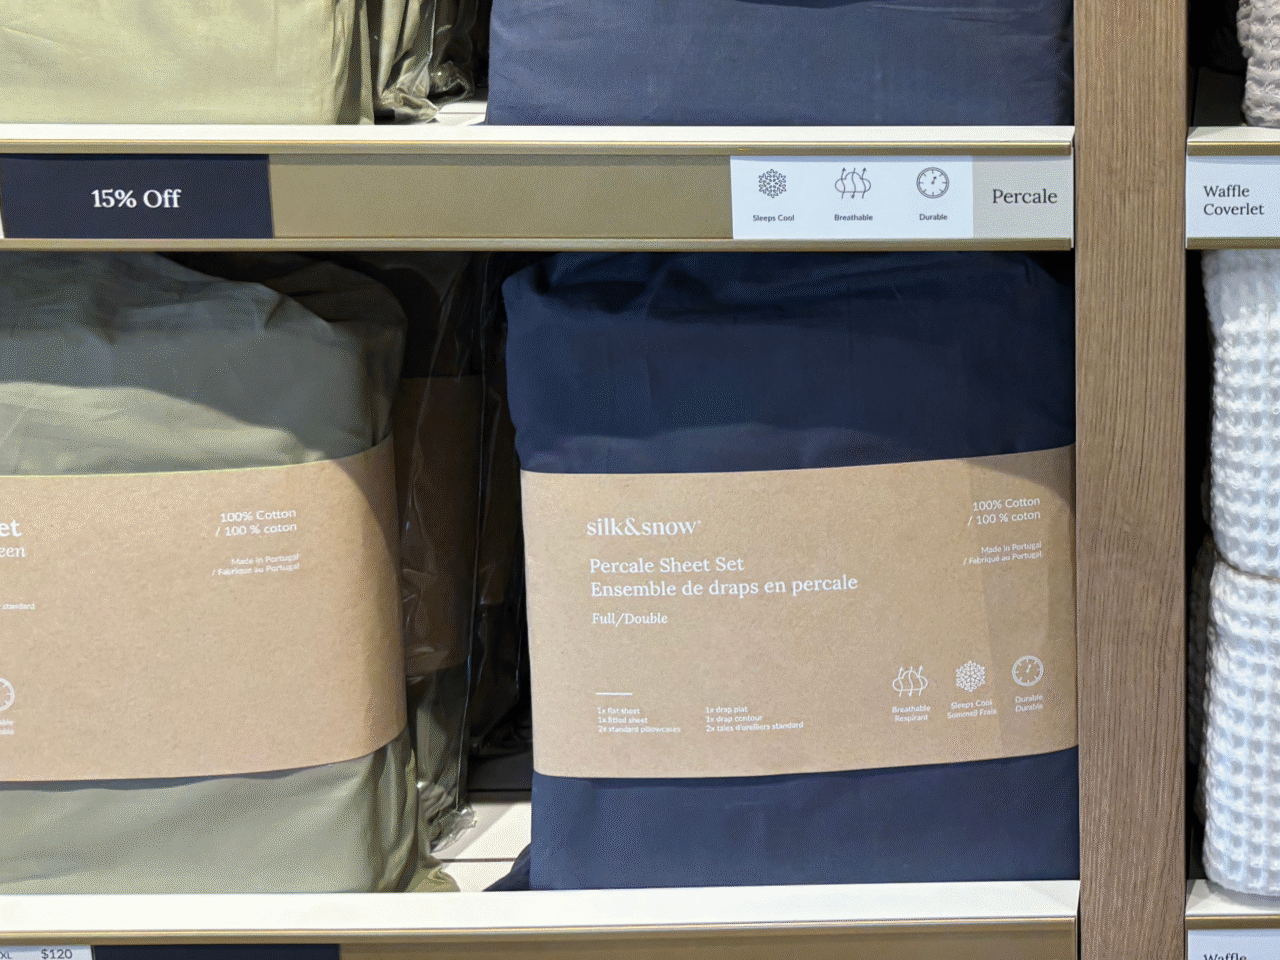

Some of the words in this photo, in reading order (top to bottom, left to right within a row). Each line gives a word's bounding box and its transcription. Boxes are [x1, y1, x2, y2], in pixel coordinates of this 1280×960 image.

[90, 188, 137, 208] 15%
[143, 188, 182, 208] Off
[992, 188, 1058, 205] Percale
[1203, 185, 1250, 198] Waffle
[1203, 202, 1265, 217] Coverlet
[752, 214, 776, 223] Sleeps
[777, 213, 795, 222] Cool
[834, 213, 874, 222] Breathable
[919, 212, 948, 222] Durable
[972, 499, 1003, 512] 100%
[1005, 497, 1041, 508] Cotton
[220, 510, 253, 523] 100%
[255, 509, 297, 521] Cotton
[976, 513, 997, 525] 100
[1011, 511, 1041, 522] coton
[225, 525, 247, 537] 100
[263, 523, 297, 534] coton
[589, 557, 655, 574] Percale
[659, 557, 711, 573] Sheet
[715, 556, 745, 572] Set
[590, 581, 677, 597] Ensemble
[681, 580, 703, 596] de
[708, 579, 759, 599] draps
[764, 581, 786, 594] en
[792, 574, 858, 597] percale
[592, 612, 668, 627] Full/Double
[41, 948, 73, 960] $120
